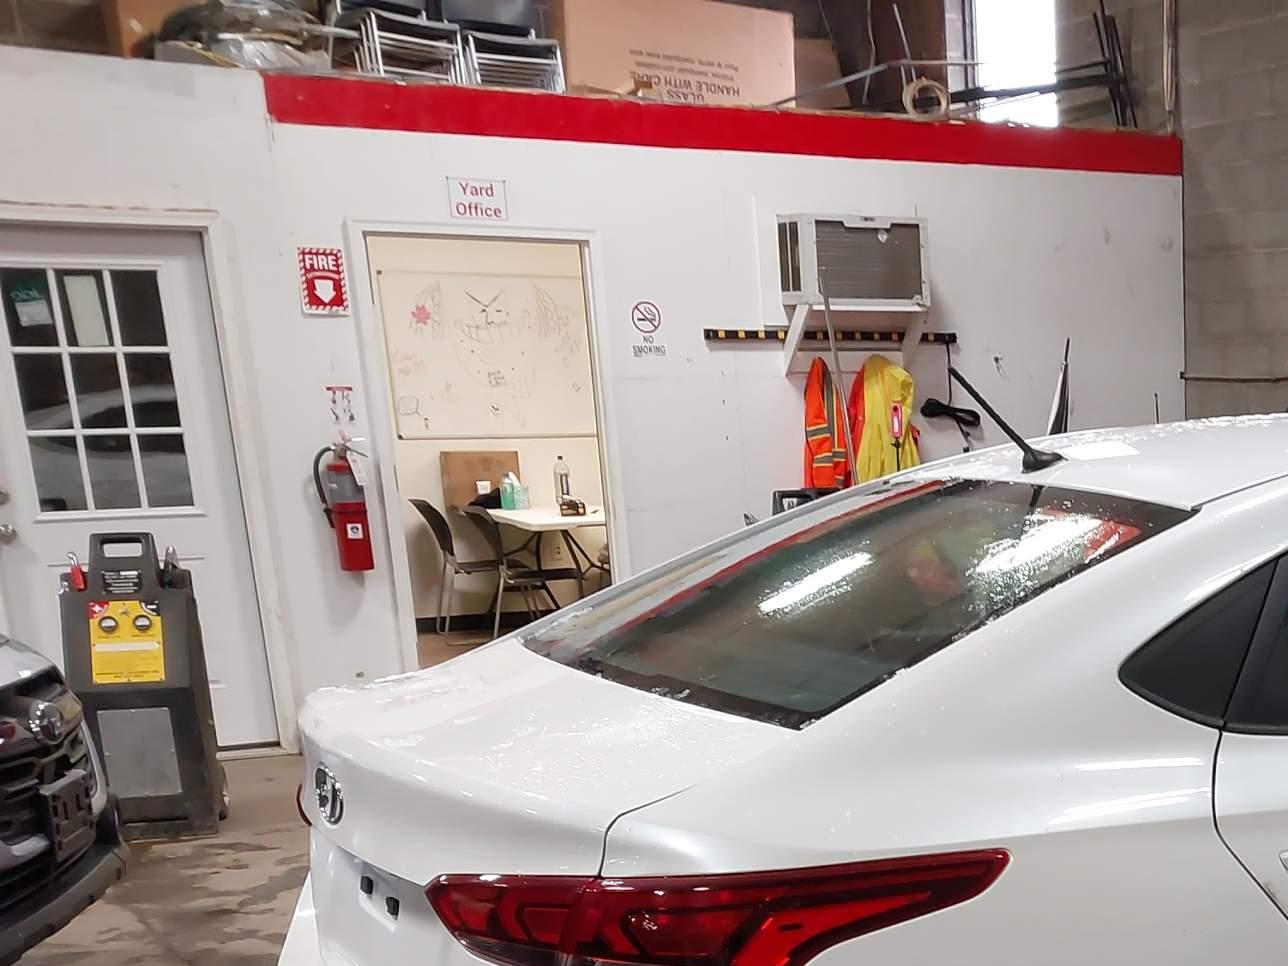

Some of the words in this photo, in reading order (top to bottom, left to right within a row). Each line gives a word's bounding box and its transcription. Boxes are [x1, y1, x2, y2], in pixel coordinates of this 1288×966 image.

[664, 77, 692, 92] WITH
[696, 81, 740, 97] HANDLE
[458, 181, 495, 197] Yard
[456, 202, 502, 218] Office
[304, 254, 338, 271] FIRE
[642, 335, 655, 344] NO
[632, 344, 666, 354] SMOKING
